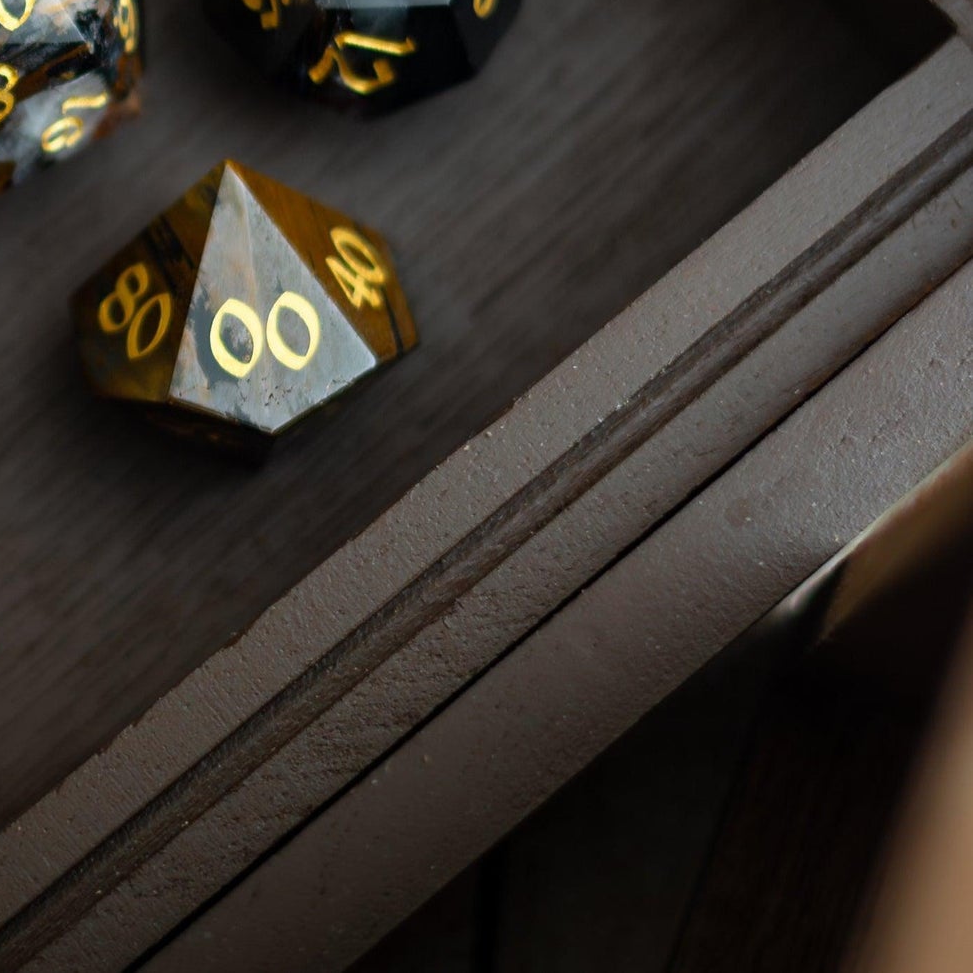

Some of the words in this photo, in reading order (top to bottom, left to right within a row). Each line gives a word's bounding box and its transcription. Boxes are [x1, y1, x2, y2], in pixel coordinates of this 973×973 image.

[308, 30, 416, 95] 12
[326, 226, 387, 309] 40
[98, 263, 172, 361] 80
[210, 290, 321, 378] 00
